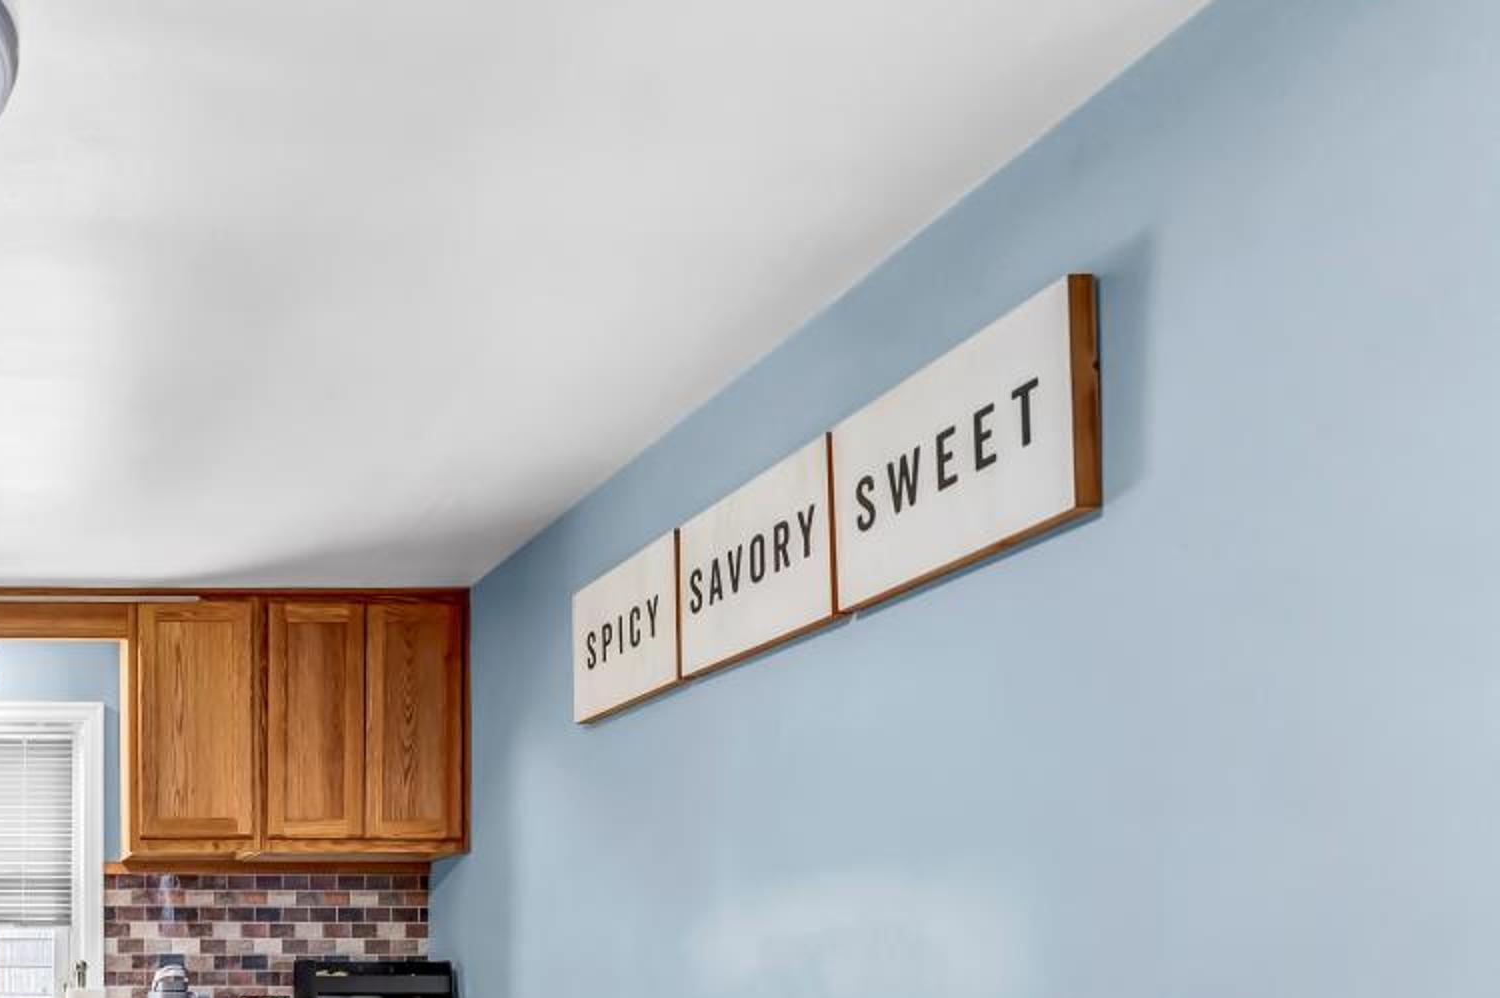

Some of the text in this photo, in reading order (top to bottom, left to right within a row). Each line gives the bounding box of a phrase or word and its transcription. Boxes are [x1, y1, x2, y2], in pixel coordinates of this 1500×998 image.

[855, 377, 1040, 532] SWEET
[689, 504, 816, 615] SAVORY
[586, 594, 660, 670] SPICY
